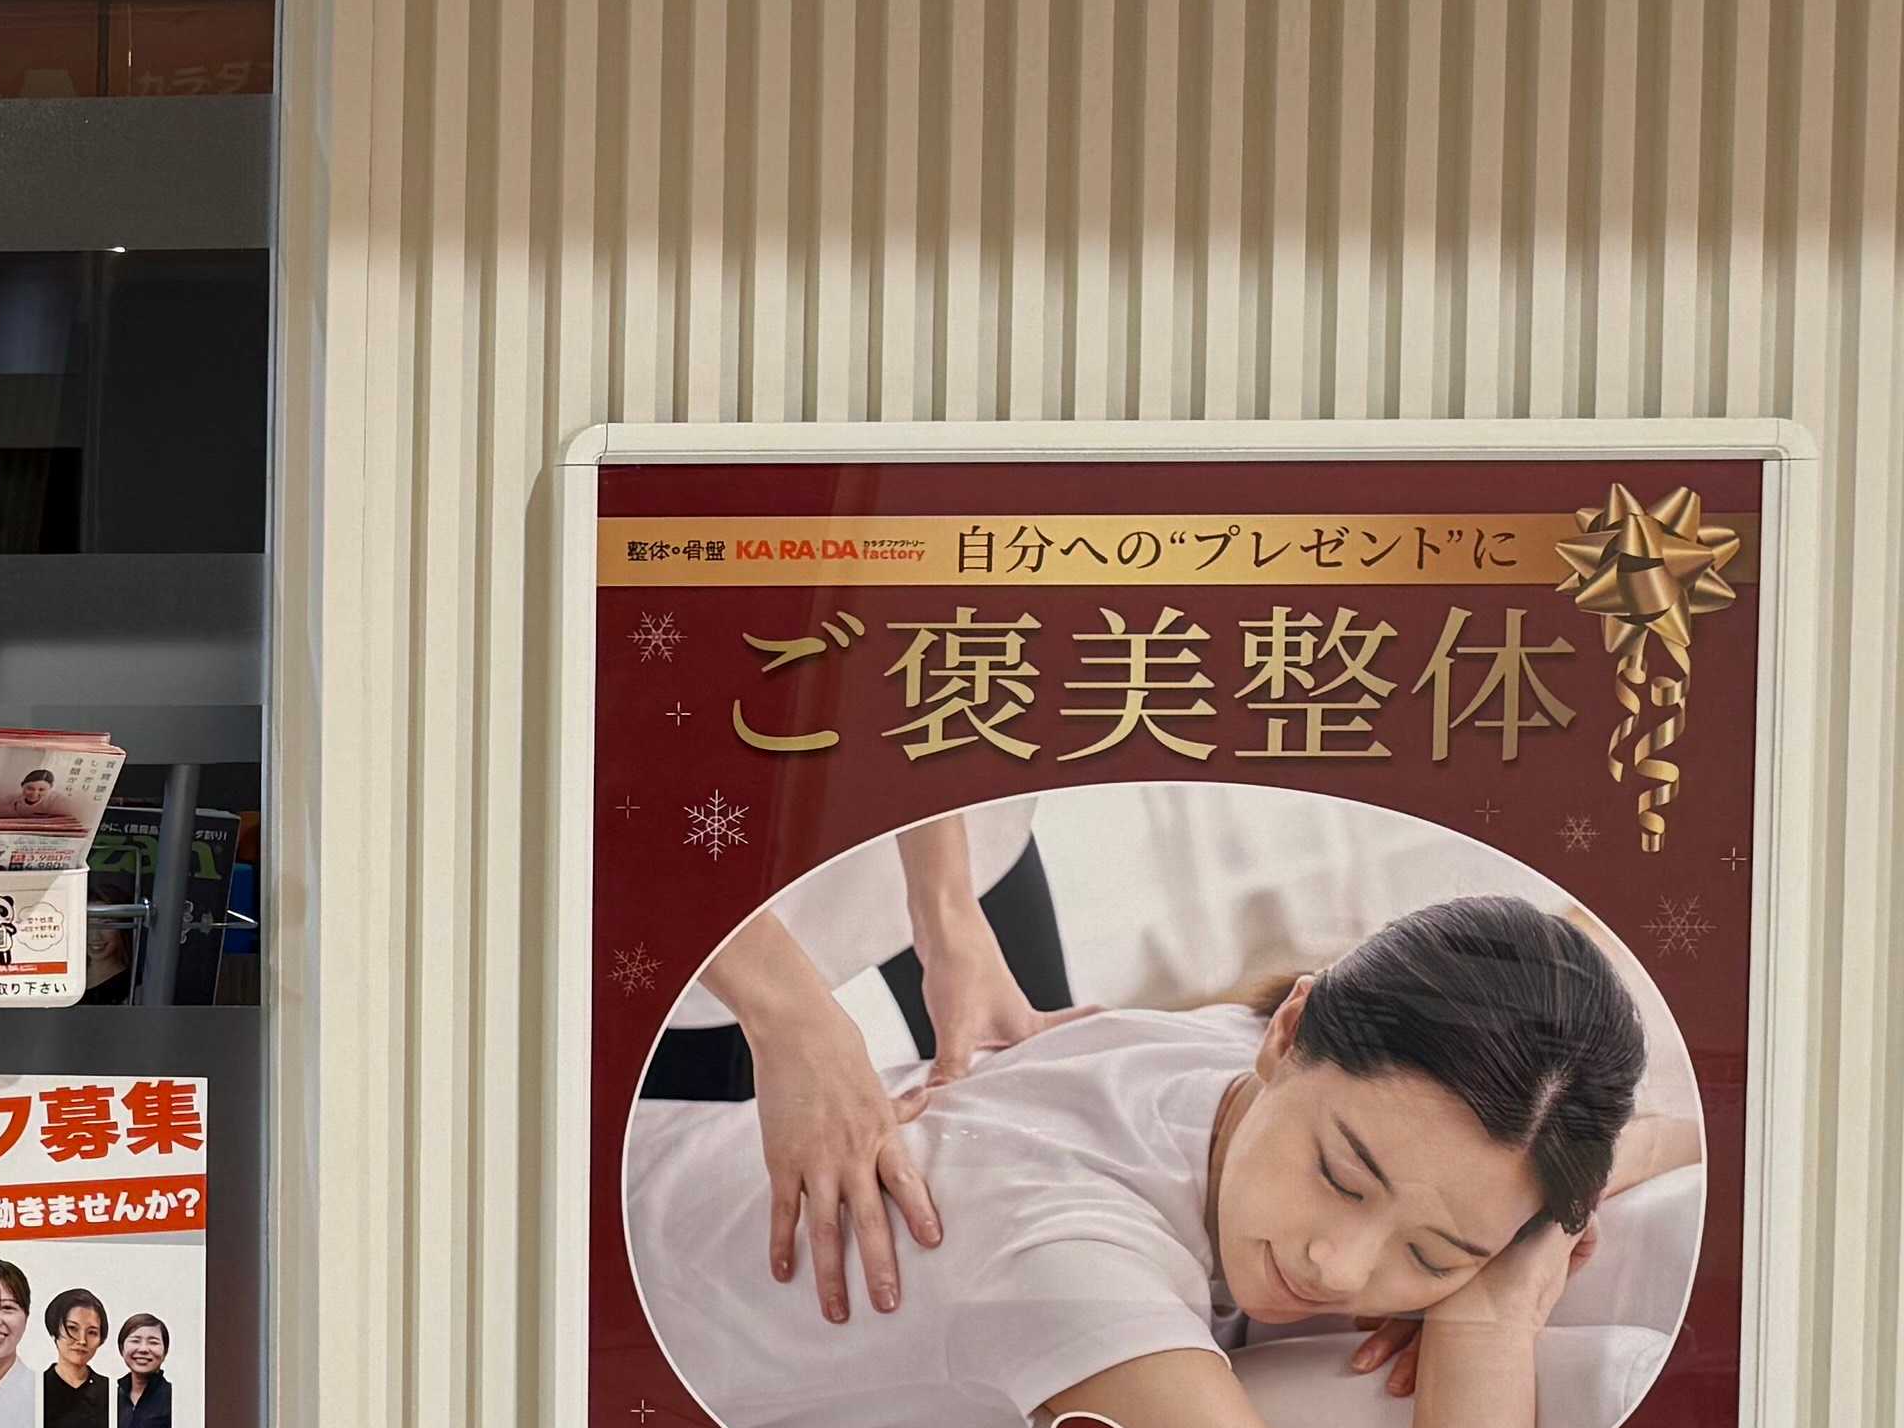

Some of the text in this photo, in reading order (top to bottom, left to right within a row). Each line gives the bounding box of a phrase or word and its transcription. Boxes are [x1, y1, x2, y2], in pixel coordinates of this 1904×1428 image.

[863, 547, 925, 562] factory
[732, 606, 1578, 764] ご褒美整体
